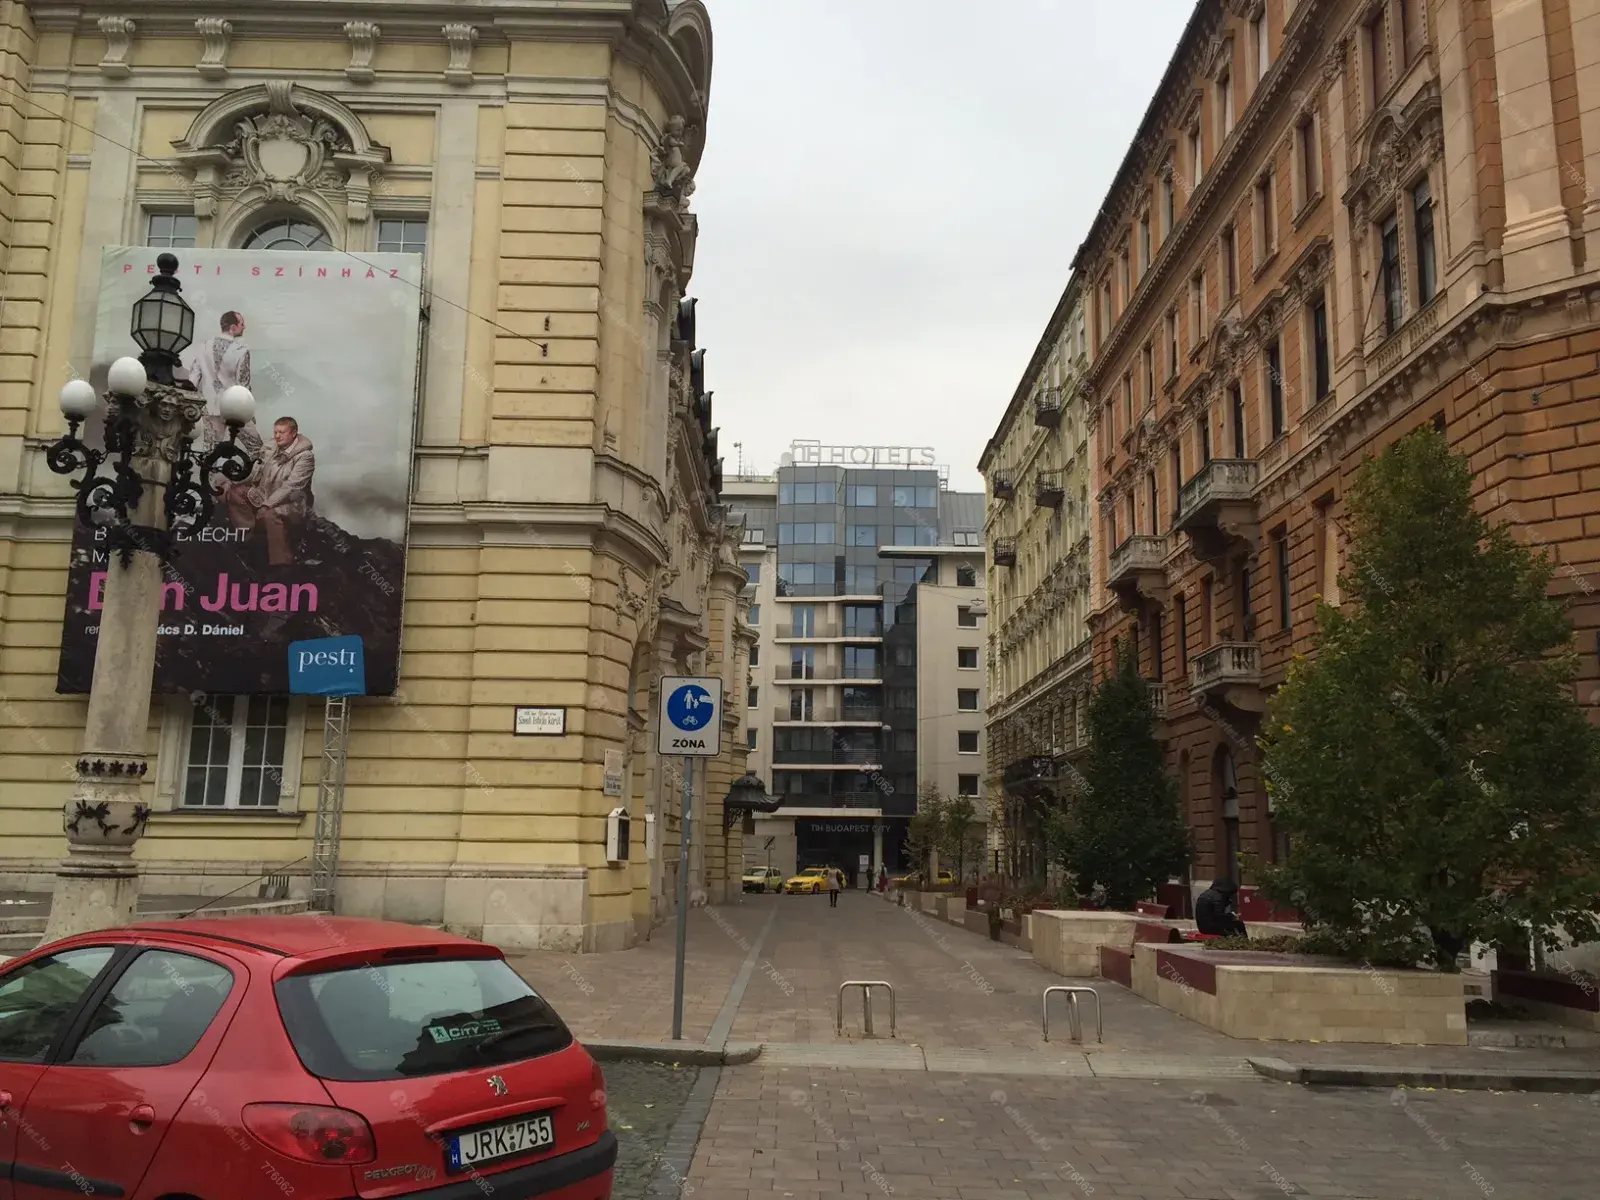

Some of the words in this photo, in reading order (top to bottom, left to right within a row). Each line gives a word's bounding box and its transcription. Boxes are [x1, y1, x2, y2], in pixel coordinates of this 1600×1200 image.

[123, 263, 221, 276] PETI
[251, 265, 399, 281] SZÍNHÁZ
[830, 444, 936, 466] HOTELS
[88, 571, 185, 611] Dn
[199, 572, 319, 613] Juan
[184, 624, 198, 636] D.
[202, 623, 245, 636] Dániel
[297, 648, 357, 674] pesti
[671, 737, 706, 749] ZÓNA
[825, 823, 871, 833] BUDAPEST
[465, 1116, 550, 1161] JRK-755
[451, 1154, 459, 1165] H
